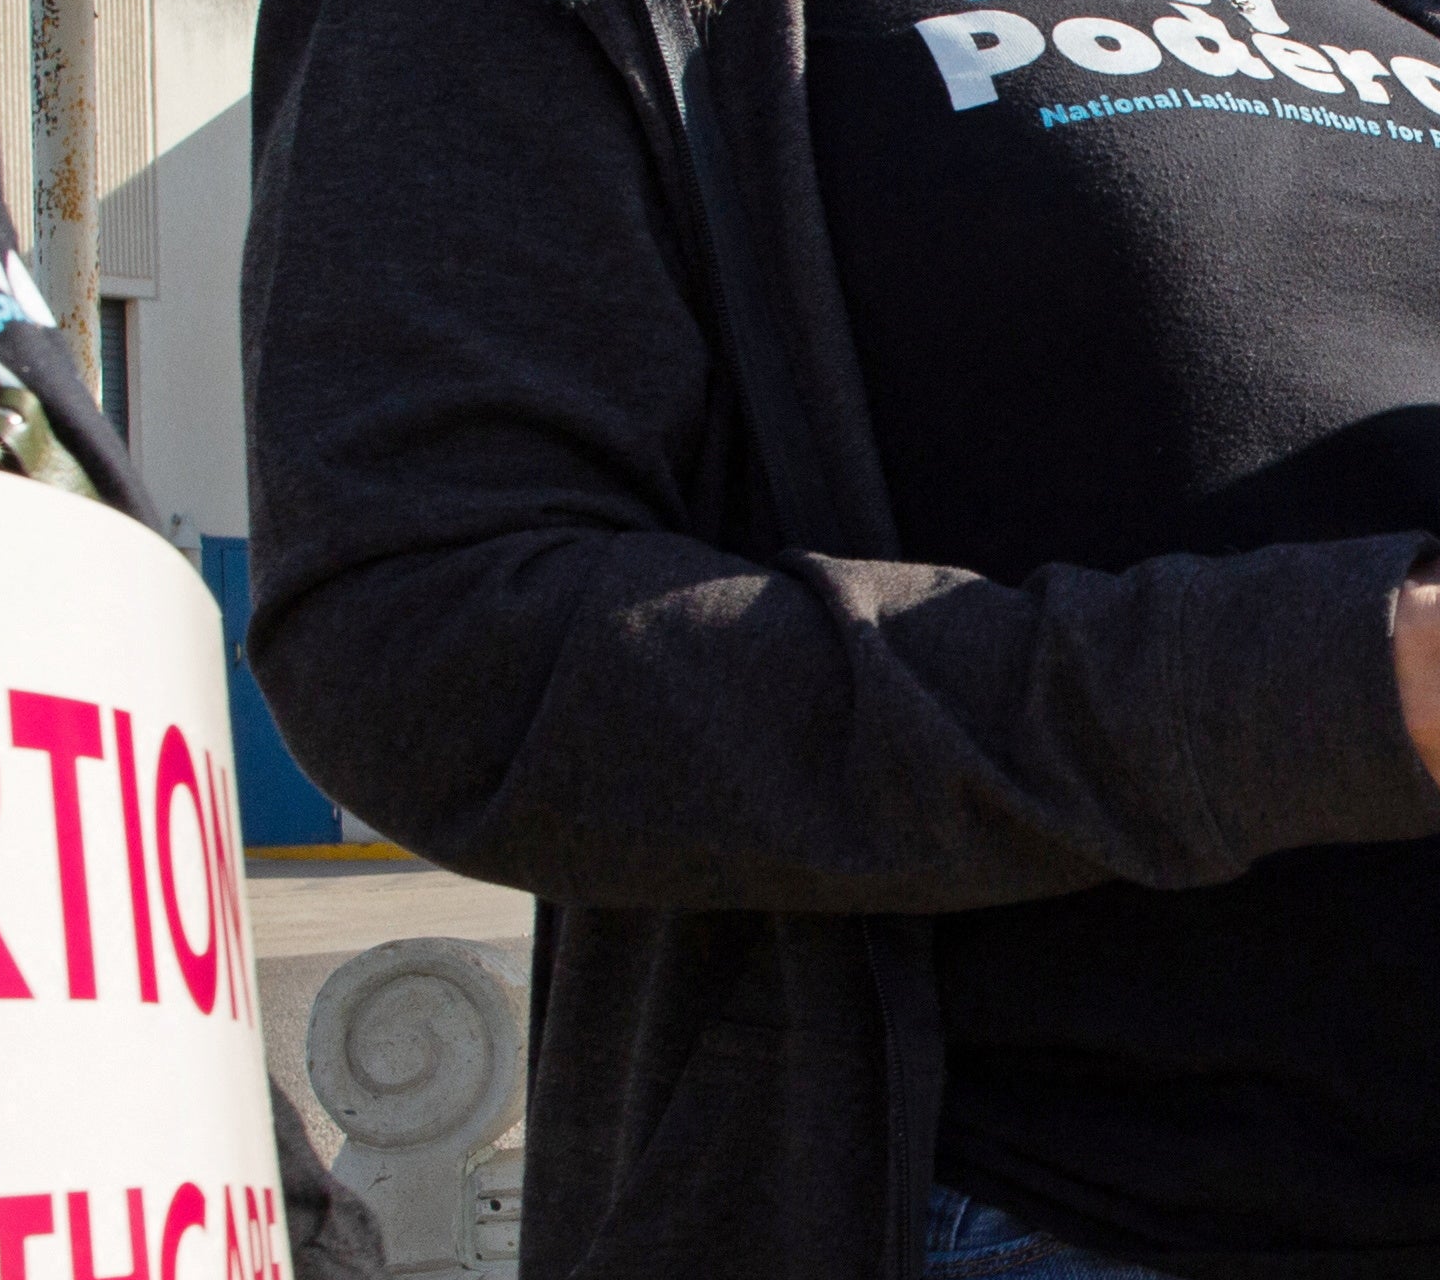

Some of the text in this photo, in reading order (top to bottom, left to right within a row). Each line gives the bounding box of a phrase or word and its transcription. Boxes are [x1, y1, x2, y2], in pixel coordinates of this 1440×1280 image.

[1039, 87, 1182, 129] National
[1181, 88, 1270, 117] Latina
[1271, 97, 1382, 136] Institute
[1386, 119, 1424, 144] for
